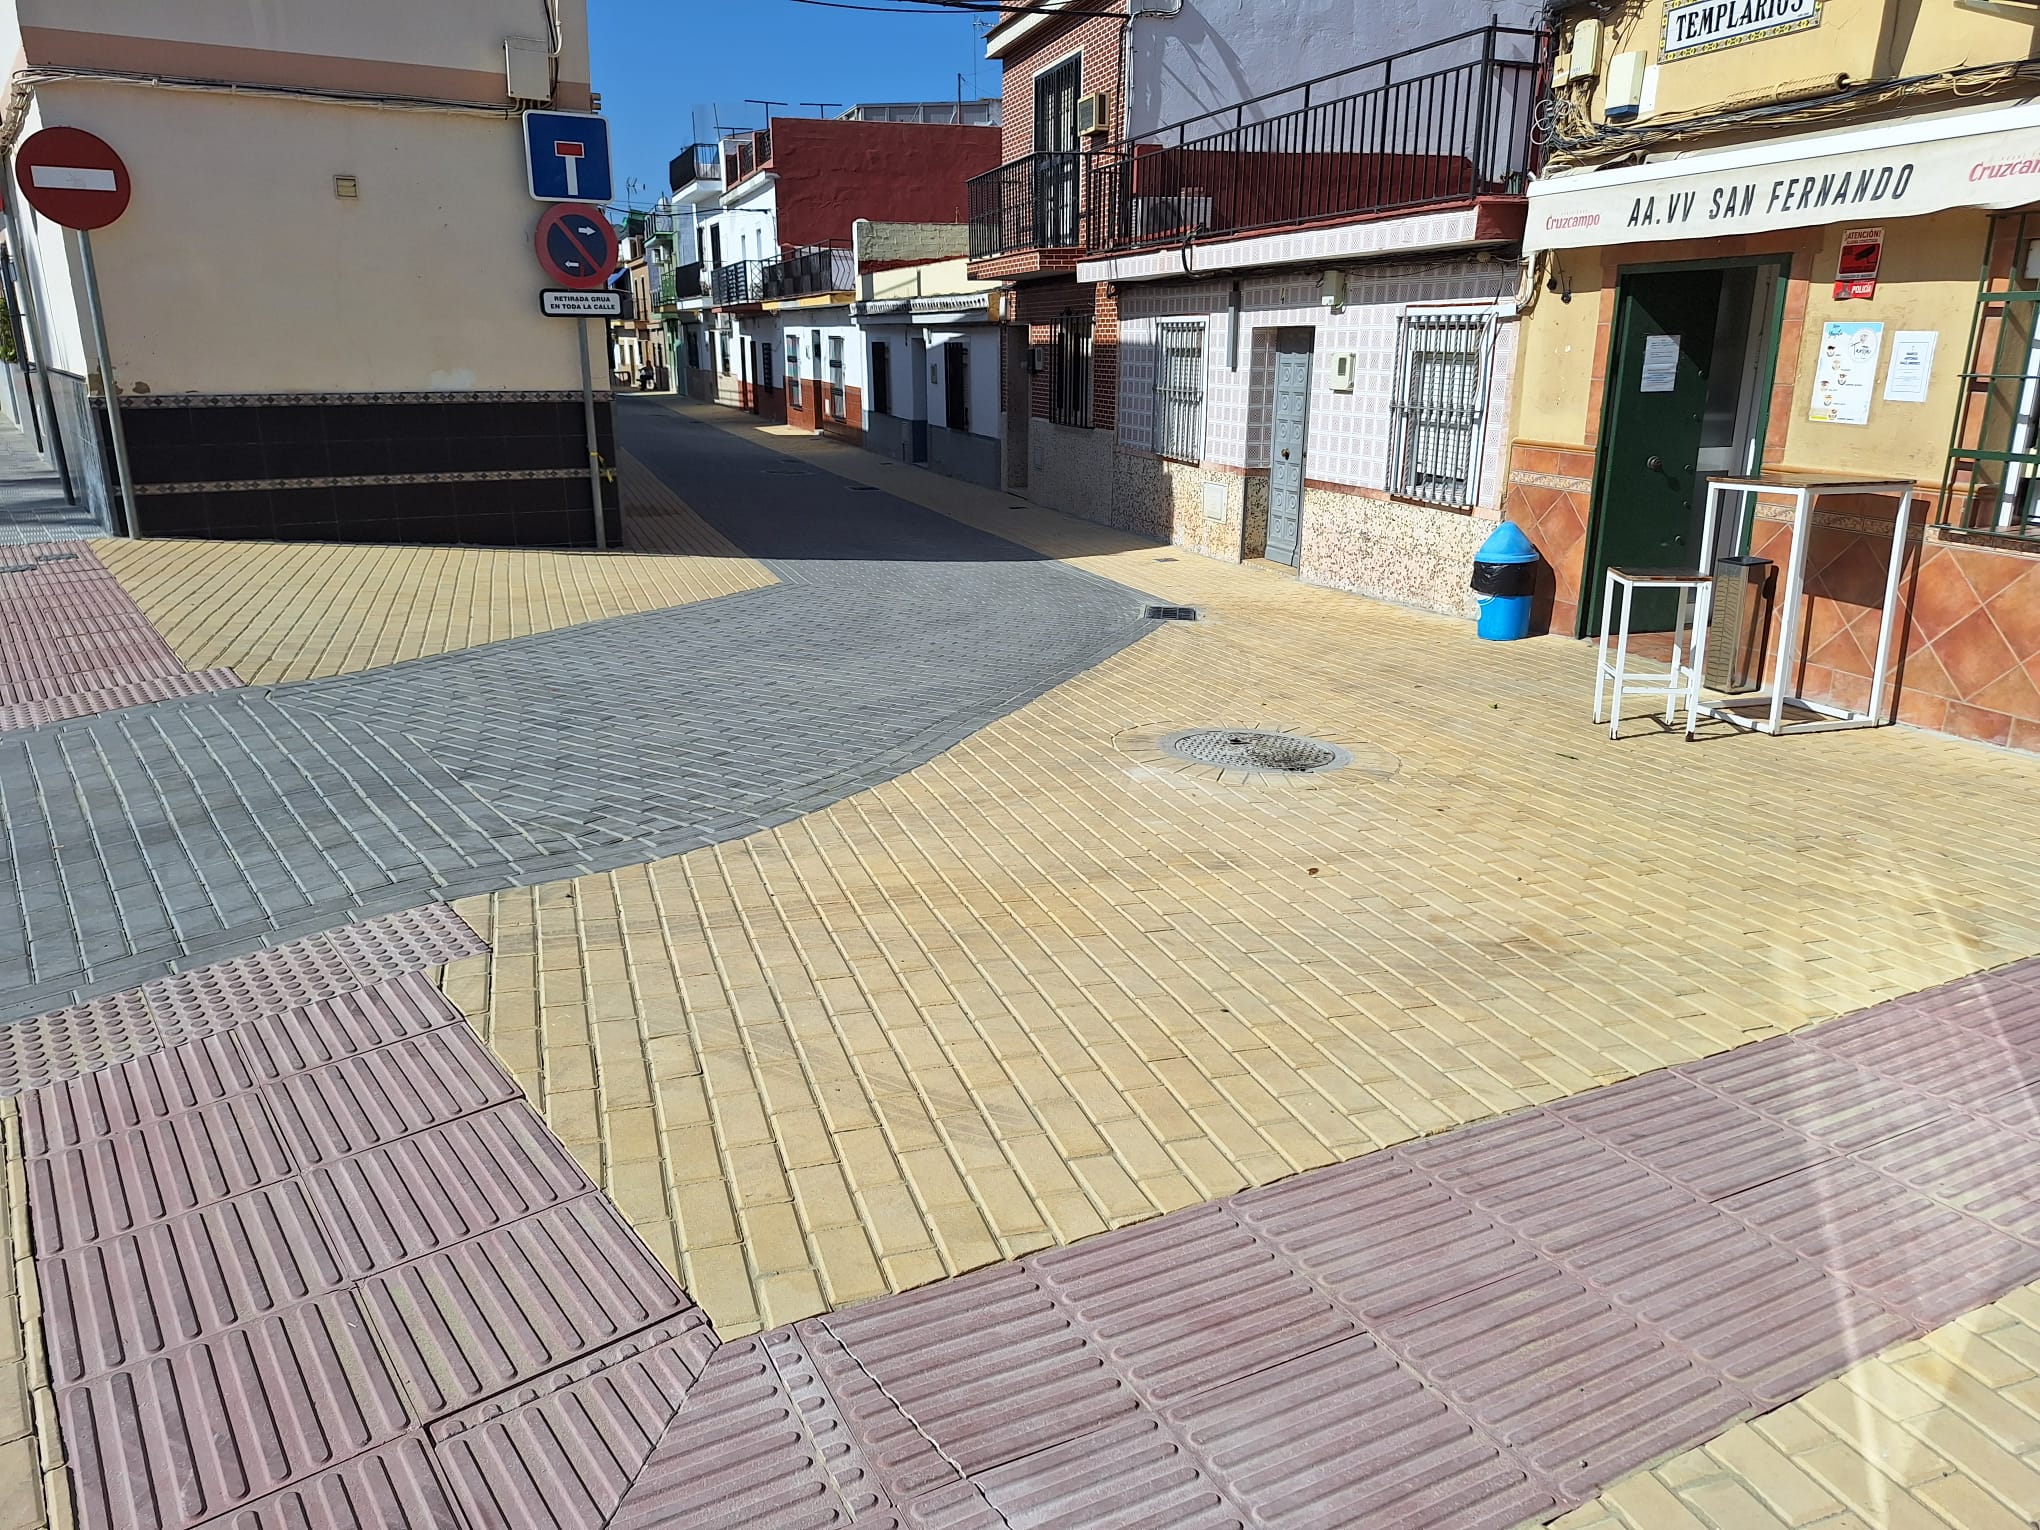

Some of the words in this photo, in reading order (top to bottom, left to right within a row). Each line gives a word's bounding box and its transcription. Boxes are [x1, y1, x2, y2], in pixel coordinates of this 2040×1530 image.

[1627, 191, 1696, 227] AA.VV
[1708, 184, 1756, 220] SAN
[1767, 163, 1914, 214] FERNANDO
[1546, 214, 1600, 230] Cruzcampo
